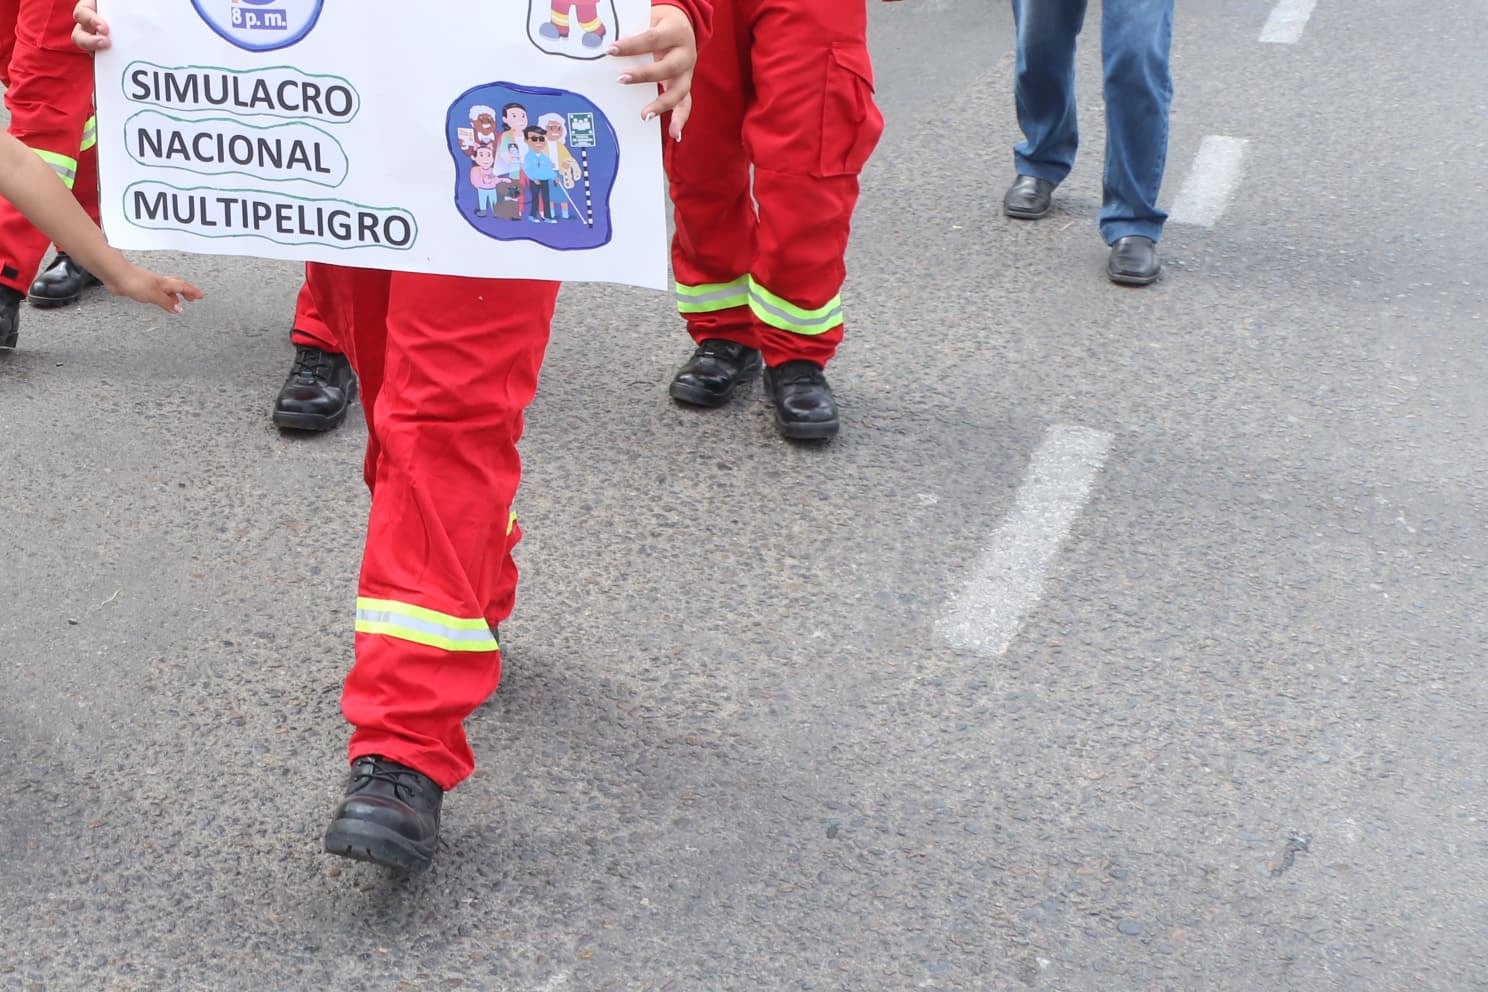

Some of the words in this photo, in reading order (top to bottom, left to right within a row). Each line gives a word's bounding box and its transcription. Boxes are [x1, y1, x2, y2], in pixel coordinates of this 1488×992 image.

[232, 7, 243, 25] 8
[131, 69, 353, 117] SIMULACRO
[138, 127, 331, 174] NACIONAL
[133, 190, 412, 248] MULTIPELIGRO
